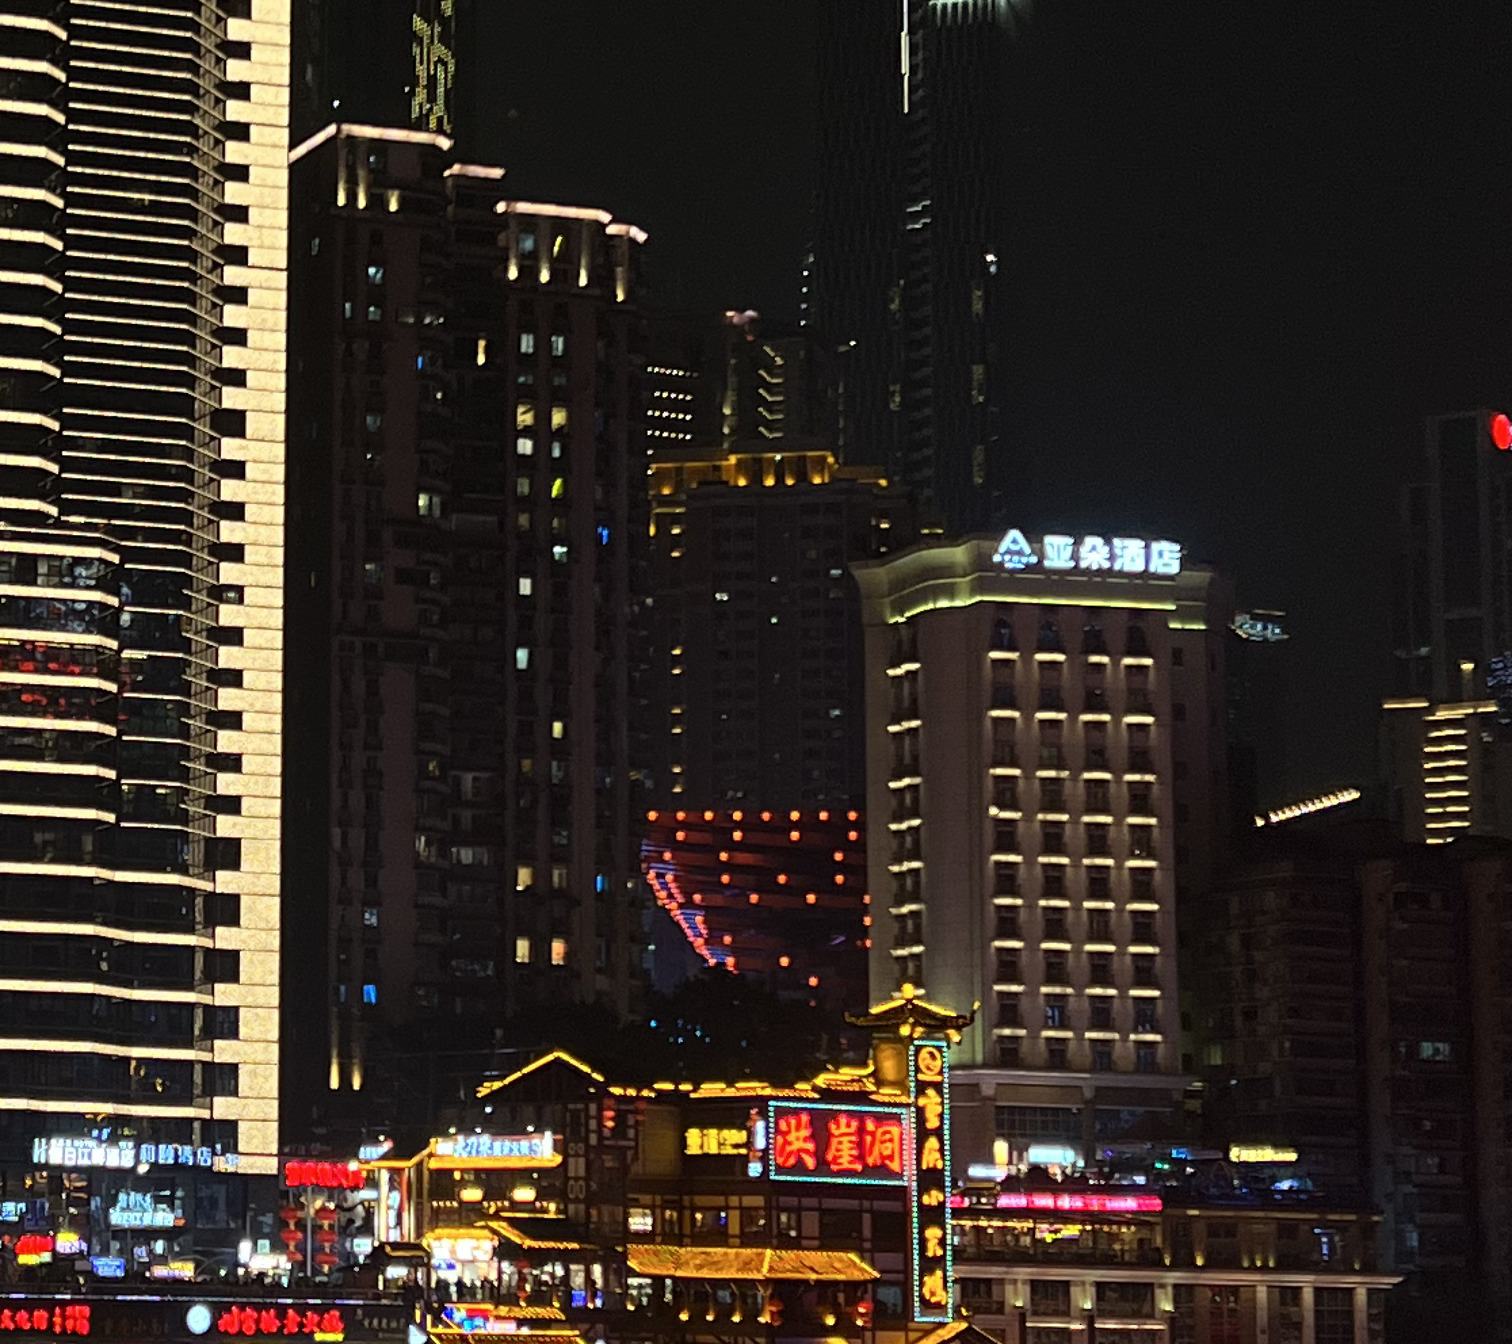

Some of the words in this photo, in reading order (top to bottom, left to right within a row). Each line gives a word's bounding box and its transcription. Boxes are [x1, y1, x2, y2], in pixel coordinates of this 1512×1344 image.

[1042, 534, 1182, 575] 亚朵酒店
[775, 1111, 903, 1174] 洪崖洞
